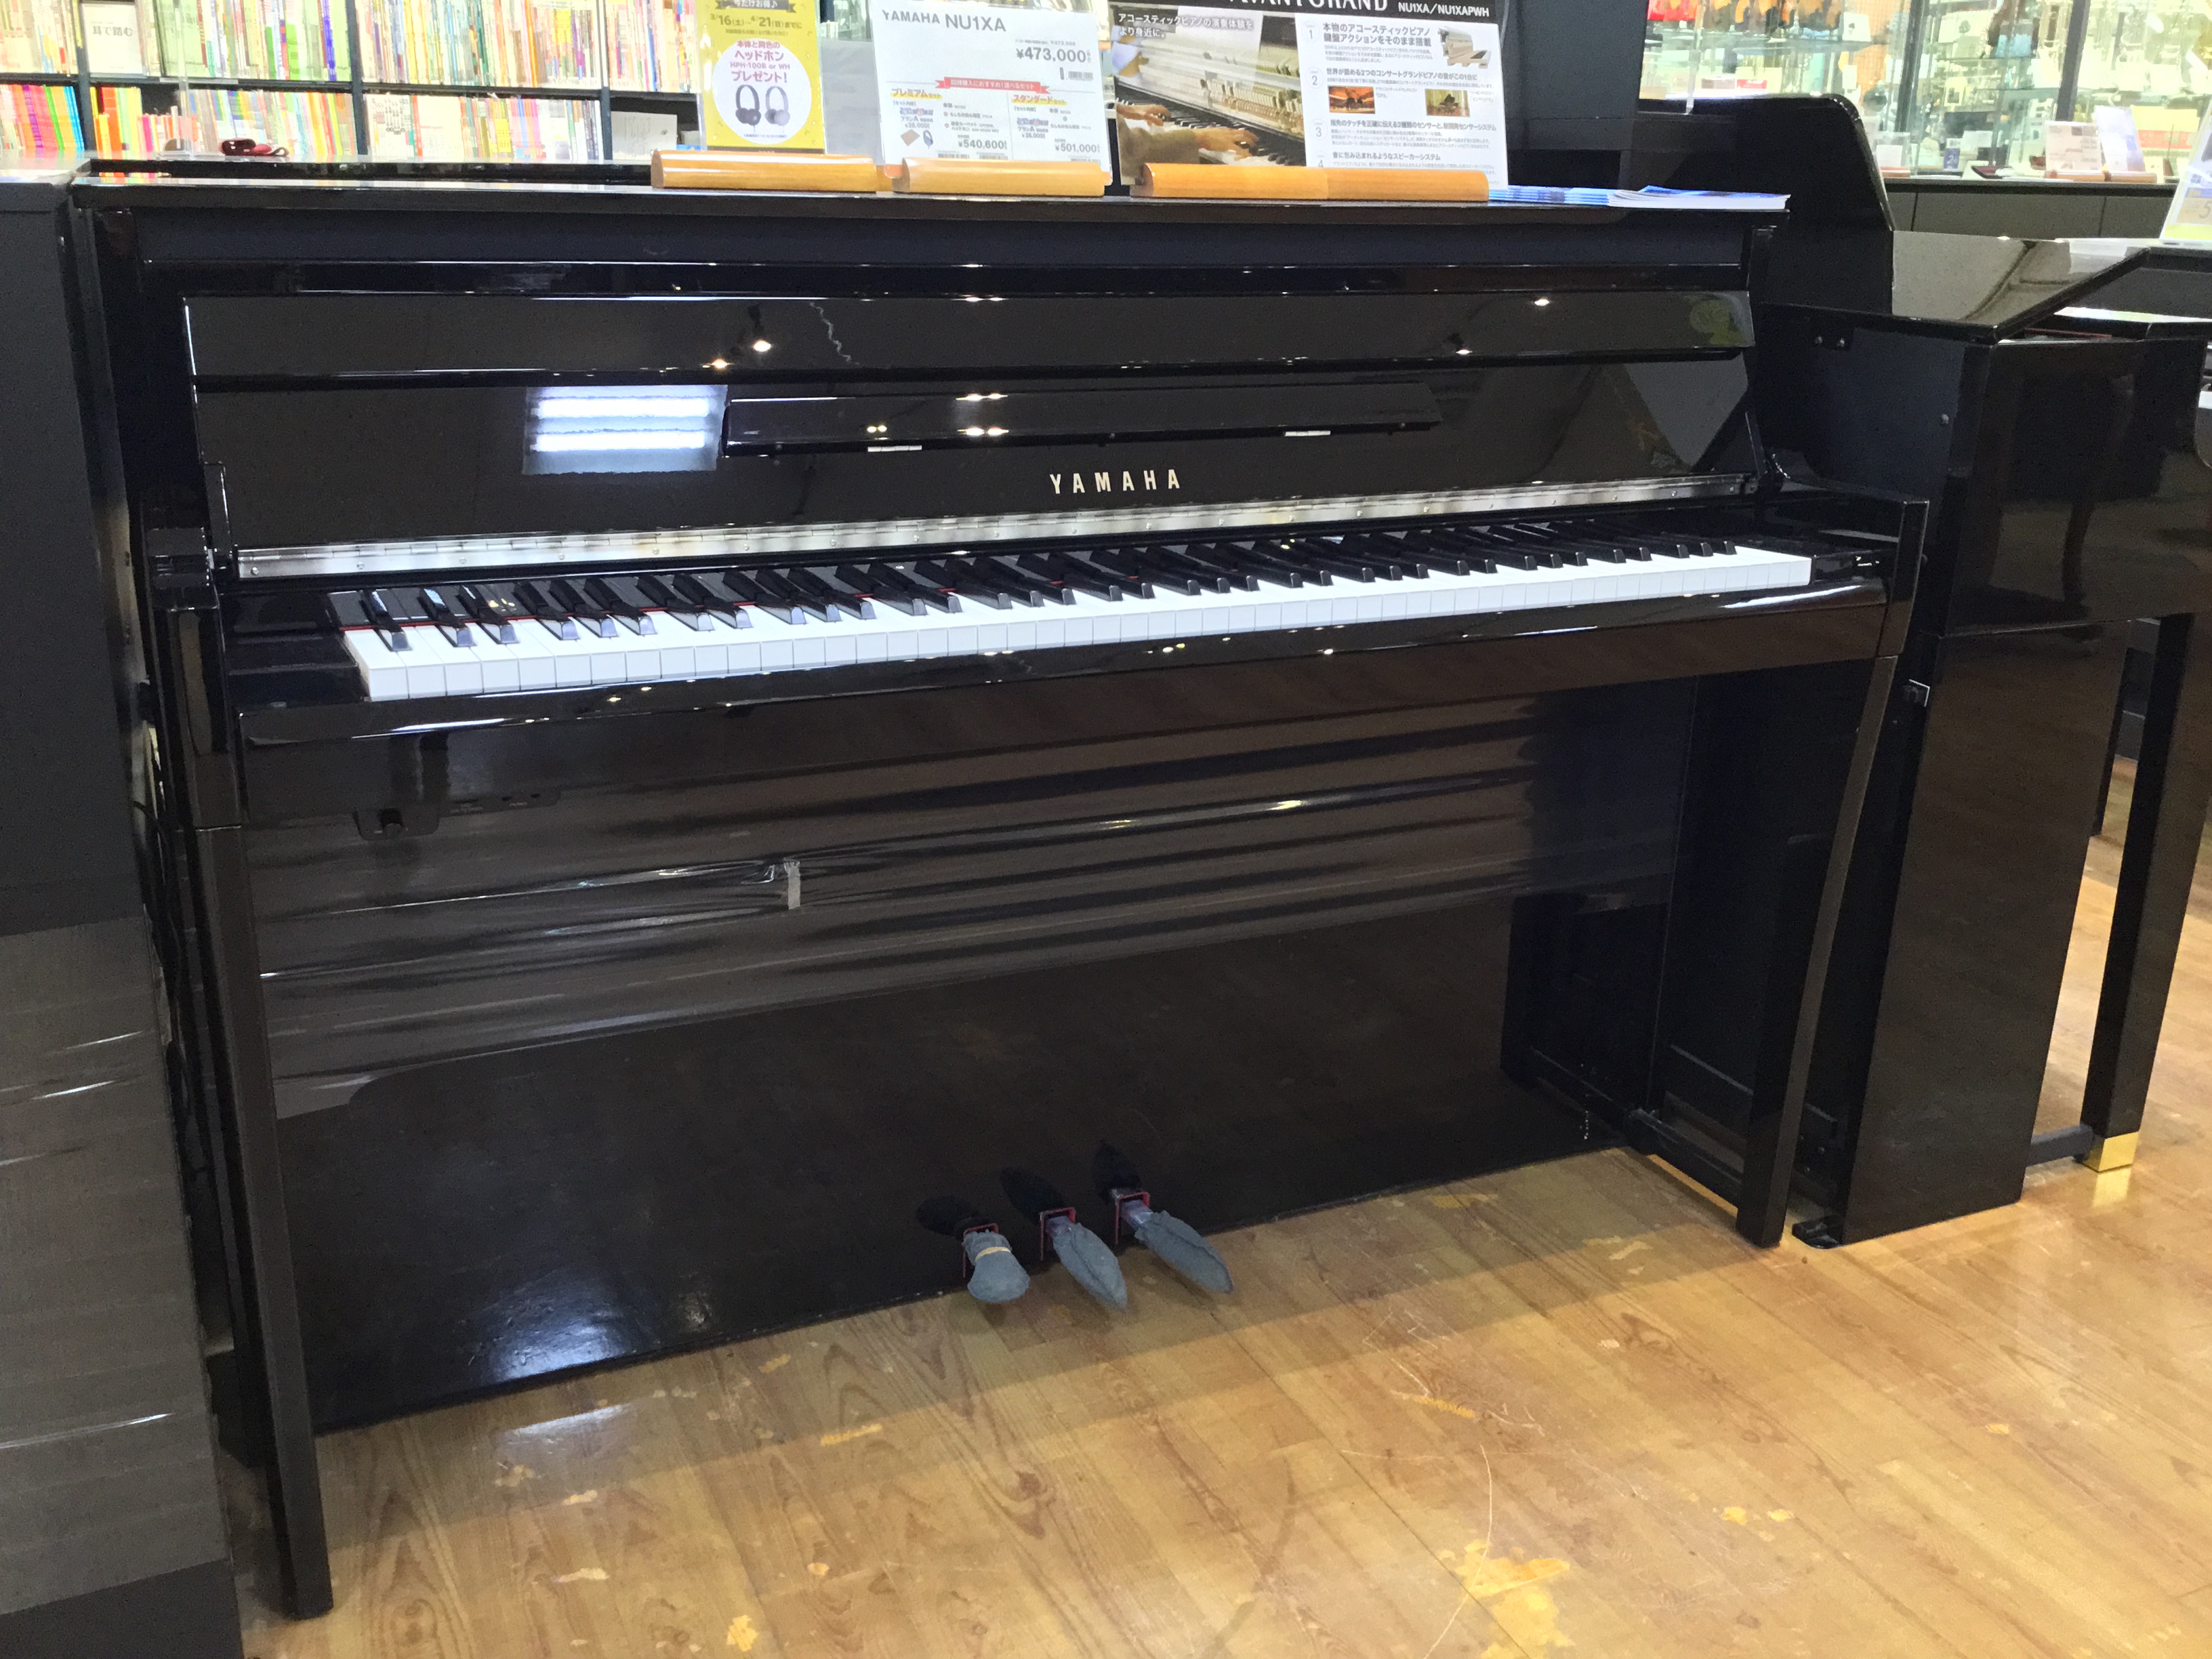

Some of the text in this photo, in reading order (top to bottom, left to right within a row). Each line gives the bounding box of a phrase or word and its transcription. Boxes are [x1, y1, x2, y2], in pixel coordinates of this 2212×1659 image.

[1398, 1, 1490, 17] NU1XA/NU1XAPWH
[882, 9, 1007, 33] YAMAHA NU1XA
[1323, 22, 1430, 36] 本物のアコースティックピアノ
[734, 50, 784, 62] ヘッドホン
[1016, 47, 1086, 62] ¥473,000
[1311, 75, 1318, 85] 2
[1315, 127, 1322, 137] 3
[1050, 468, 1181, 494] YAMAHA
